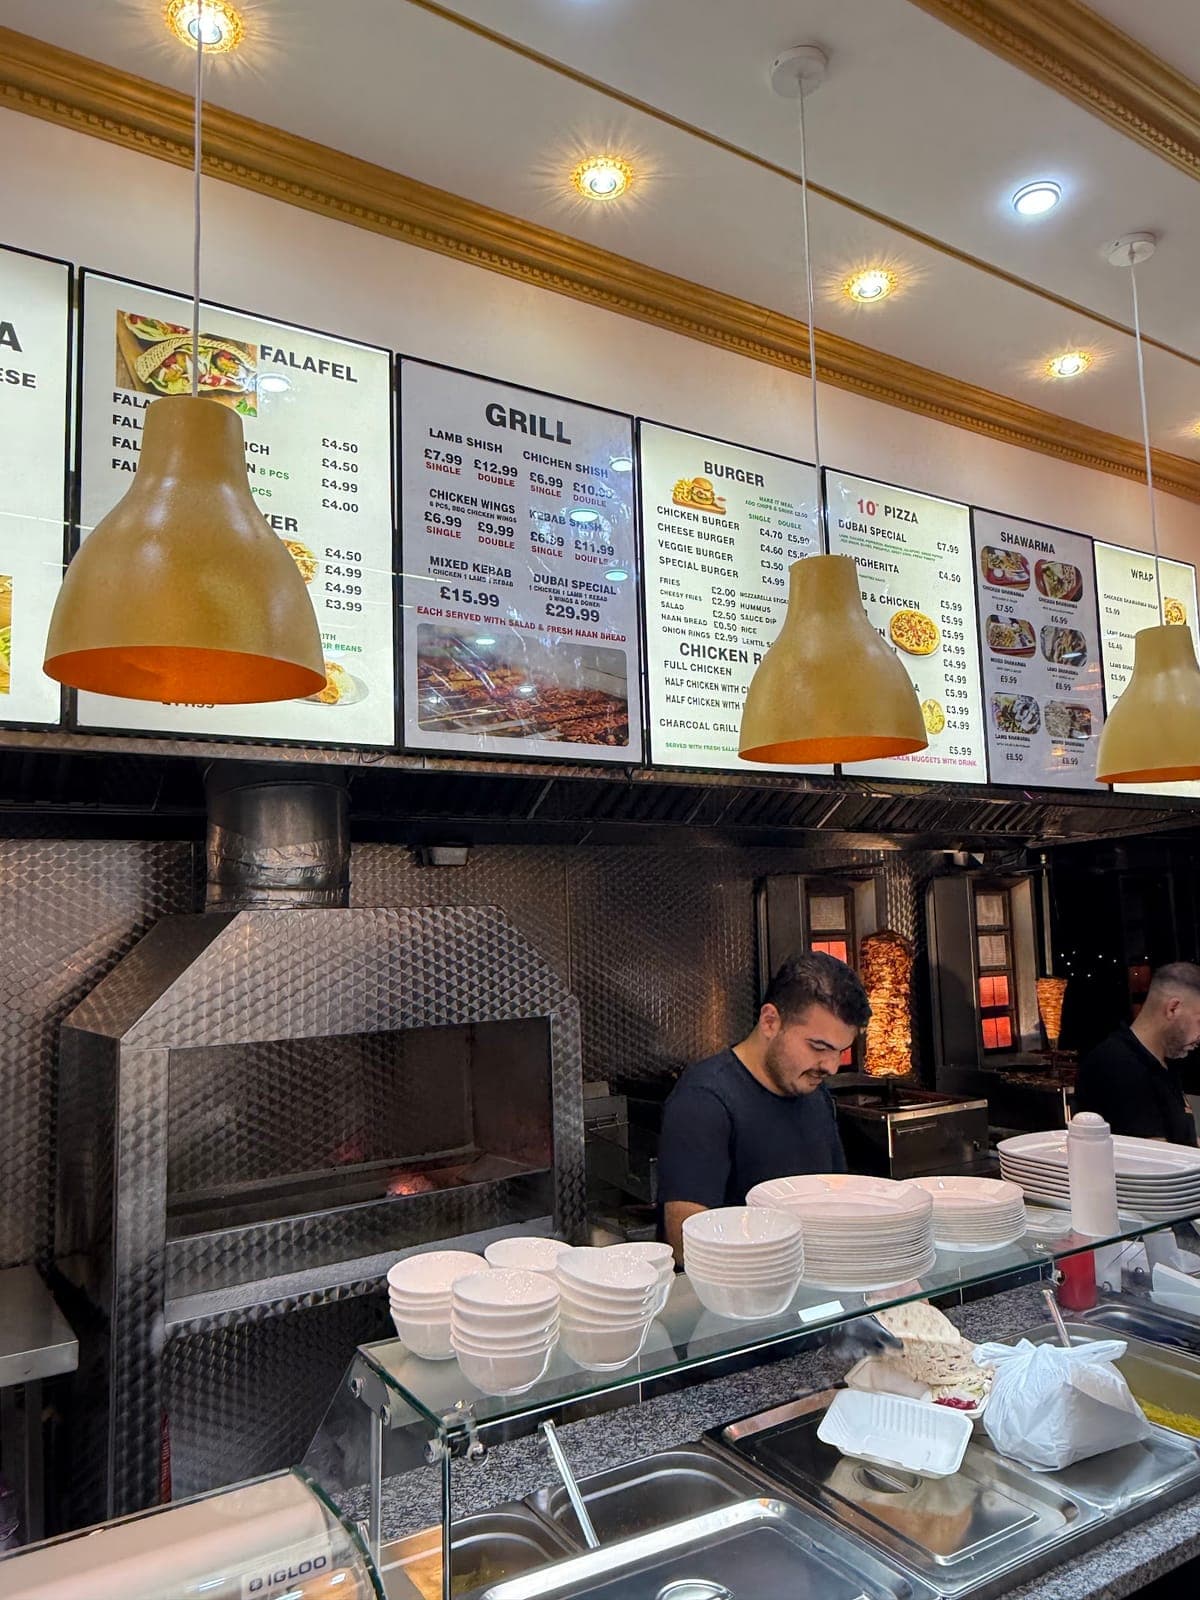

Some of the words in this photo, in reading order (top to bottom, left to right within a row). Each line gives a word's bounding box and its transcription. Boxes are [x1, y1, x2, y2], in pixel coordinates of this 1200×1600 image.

[260, 344, 358, 383] FALAFEL
[485, 402, 572, 445] GRILL
[321, 438, 359, 454] £4.50
[429, 427, 463, 444] LAMB
[466, 437, 503, 454] SHISH
[321, 458, 359, 474] £4.50
[424, 448, 463, 466] £7.99
[473, 459, 518, 478] £12.99
[575, 463, 609, 479] SHISH
[269, 469, 290, 481] PCS
[425, 461, 462, 476] SINGLE
[477, 473, 516, 488] DOUBLE
[529, 472, 563, 488] £6.99
[703, 460, 765, 488] BURGER
[321, 478, 359, 494] £4.99
[429, 488, 478, 507] CHICKEN
[480, 499, 516, 514] WINGS
[530, 485, 562, 498] SINGLE
[573, 495, 607, 508] DOUBLE
[321, 498, 359, 514] £4.00
[452, 505, 466, 514] BBQ
[466, 508, 495, 520] CHICKEN
[496, 514, 517, 523] WINGS
[529, 509, 566, 525] KEBAB
[656, 505, 699, 523] CHICKEN
[702, 515, 740, 531] BURGER
[748, 513, 771, 524] SINGLE
[777, 519, 802, 530] DOUBLE
[884, 505, 919, 525] PIZZA
[424, 511, 462, 528] £6.99
[477, 521, 514, 538] £9.99
[838, 519, 867, 534] DUBAI
[870, 526, 907, 543] SPECIAL
[426, 525, 462, 539] SINGLE
[478, 535, 515, 550] DOUBLE
[657, 522, 695, 538] CHEESE
[697, 530, 735, 546] BURGER
[759, 527, 783, 540] £4.70
[574, 539, 615, 557] £11.99
[657, 538, 694, 554] VEGGIE
[695, 547, 734, 562] BURGER
[1000, 531, 1056, 555] SHAWARMA
[325, 547, 362, 563] £4.50
[531, 545, 563, 558] SINGLE
[574, 553, 609, 565] DOUBLE
[325, 564, 362, 580] £4.99
[429, 555, 469, 571] MIXED
[472, 562, 512, 578] KEBAB
[432, 568, 462, 579] CHICKEN
[659, 555, 699, 571] SPECIAL
[701, 564, 739, 579] BURGER
[659, 576, 681, 587] FRIES
[761, 575, 785, 587] £4.99
[1130, 568, 1154, 582] WRAP
[325, 581, 362, 597] £4.99
[533, 573, 568, 587] DUBAI
[571, 579, 617, 595] SPECIAL
[533, 585, 561, 595] CHICKEN
[711, 586, 736, 598] £2.00
[440, 585, 500, 608] £15.99
[659, 589, 684, 598] CHEESY
[685, 593, 703, 602] FRIES
[879, 594, 920, 610] CHICKEN
[325, 598, 362, 614] £3.99
[545, 602, 600, 623] £29.99
[660, 600, 685, 611] SALAD
[711, 597, 736, 608] £2.99
[740, 602, 772, 613] HUMMUS
[416, 605, 443, 617] EACH
[445, 609, 481, 622] SERVED
[483, 615, 506, 626] WITH
[508, 618, 536, 630] SALAD
[546, 625, 573, 636] FRESH
[575, 629, 598, 639] NAAN
[600, 631, 626, 642] BREAD
[683, 616, 708, 626] BREAD
[712, 610, 737, 621] £2.50
[740, 613, 764, 623] SAUCE
[765, 617, 777, 625] DIP
[662, 625, 686, 635] ONION
[688, 629, 711, 639] RINGS
[741, 626, 758, 635] RICE
[714, 632, 739, 643] £2.99
[742, 637, 765, 647] LENTIL
[335, 643, 363, 653] BEANS
[679, 642, 748, 664] CHICKEN
[663, 660, 688, 671] FULL
[690, 663, 732, 676] CHICKEN
[664, 676, 685, 687] HALF
[686, 679, 719, 691] CHICKEN
[720, 683, 739, 694] WITH
[945, 688, 968, 699] £5.99
[665, 694, 686, 704] HALF
[687, 696, 720, 708] CHICKEN
[721, 701, 740, 710] WITH
[659, 718, 710, 731] CHARCOAL
[712, 723, 739, 733] GRILL
[947, 720, 970, 730] £4.99
[949, 745, 972, 756] £5.99
[267, 1555, 327, 1587] IGLOO
